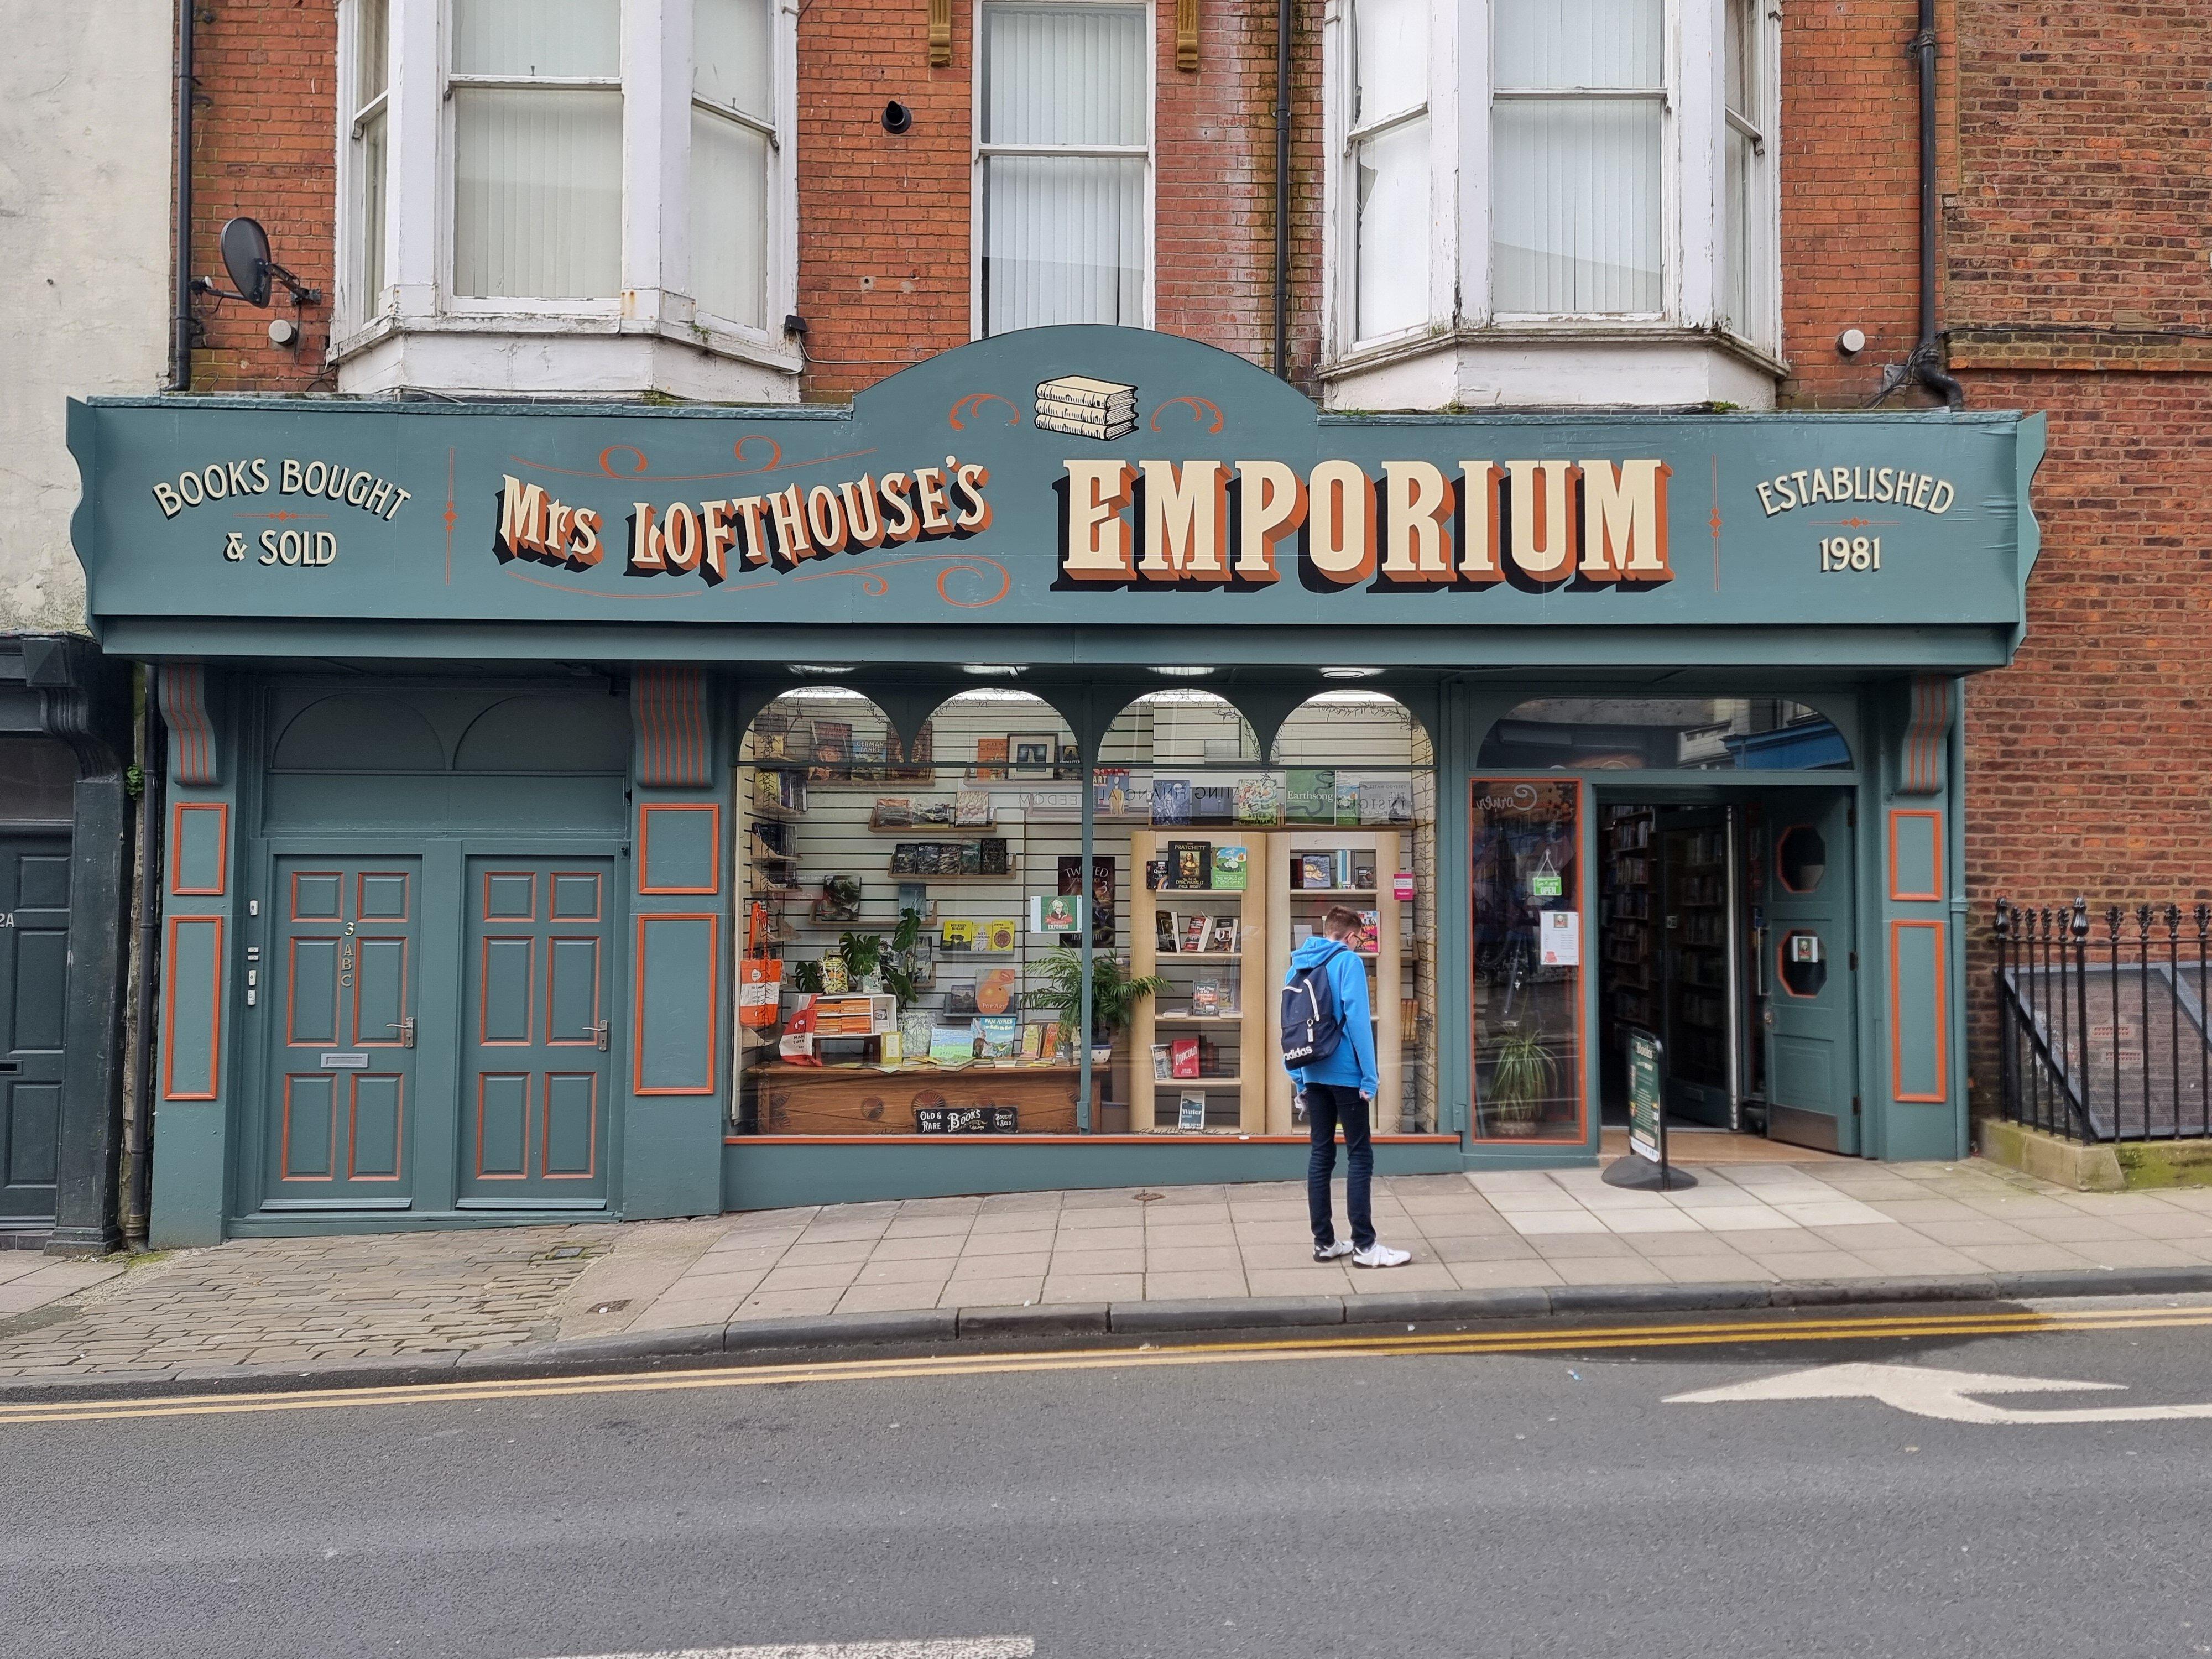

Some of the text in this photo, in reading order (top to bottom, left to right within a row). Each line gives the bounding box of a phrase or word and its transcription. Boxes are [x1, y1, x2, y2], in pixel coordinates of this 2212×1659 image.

[152, 458, 412, 521] BOOKS BOUGHT
[1756, 466, 1954, 518] ESTABLISHED
[493, 456, 1675, 593] Mrs LOFTHOUSE'S EMPORIUM
[223, 529, 337, 567] & SOLD
[1820, 535, 1881, 573] 1981
[1093, 775, 1107, 784] ART
[1287, 791, 1334, 802] Earthsong
[1064, 865, 1109, 878] TWED
[1100, 880, 1108, 894] 3
[344, 922, 354, 936] 3
[343, 943, 354, 956] A
[341, 958, 352, 971] B
[341, 974, 352, 988] C
[1175, 1046, 1197, 1066] DRACULA
[1283, 1046, 1313, 1061] adidas
[920, 1111, 935, 1120] OLD
[947, 1110, 981, 1133] BOOKS
[922, 1120, 941, 1133] RARE
